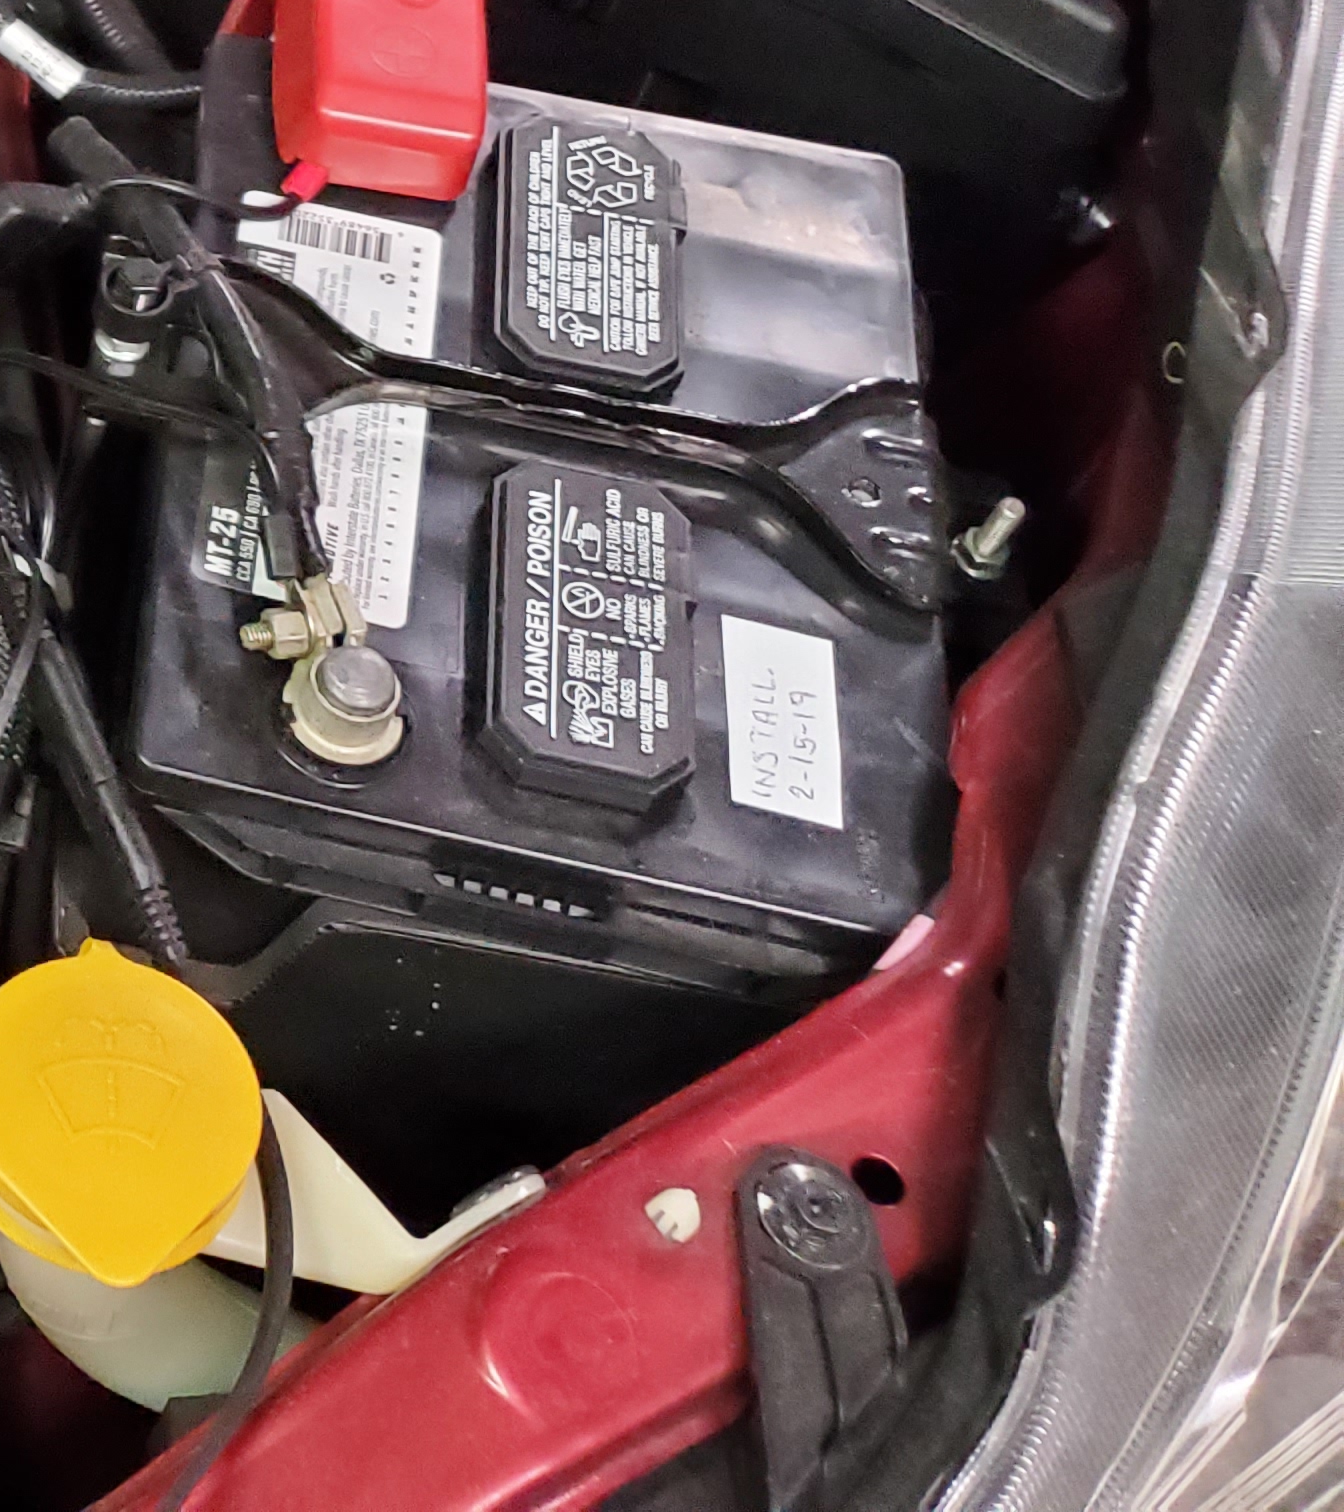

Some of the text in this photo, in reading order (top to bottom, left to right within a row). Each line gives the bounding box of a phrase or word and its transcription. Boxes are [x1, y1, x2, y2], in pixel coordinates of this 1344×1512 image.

[541, 163, 551, 180] AND
[542, 139, 552, 162] LEVEL
[541, 181, 551, 205] TIGHT
[644, 164, 654, 200] RECYCLE
[527, 152, 540, 308] KEEP OUT OF THE REACH OF CHILDREN
[540, 208, 551, 229] CAPS
[540, 231, 550, 251] VENT
[539, 254, 550, 276] KEEP
[557, 208, 572, 309] FLUSH EYES IMMEDIATELY
[573, 241, 586, 258] GET
[588, 235, 601, 315] MEDICAL HELP FAST
[538, 296, 550, 313] NOT
[538, 315, 550, 328] DO
[572, 291, 585, 311] WITH
[204, 506, 240, 576] MT-25
[236, 561, 250, 581] CCA
[243, 516, 257, 529] CA
[528, 491, 551, 577] POISON
[606, 489, 621, 572] SULFURIC ACID
[623, 521, 635, 575] CAN CAUSE
[637, 507, 650, 578] BLINDNESS OR
[652, 513, 665, 582] SEVERE BURNS
[606, 599, 621, 620] NO
[525, 599, 549, 700] DANGER
[568, 634, 584, 678] SHIELD
[585, 650, 601, 682] EYES
[602, 648, 617, 716] EXPLOSIVE
[621, 678, 636, 718] GASES
[640, 651, 653, 753] CAN CAUSE BLINDNESS
[655, 678, 668, 729] OR INJURY
[788, 691, 817, 800] 2-15-19
